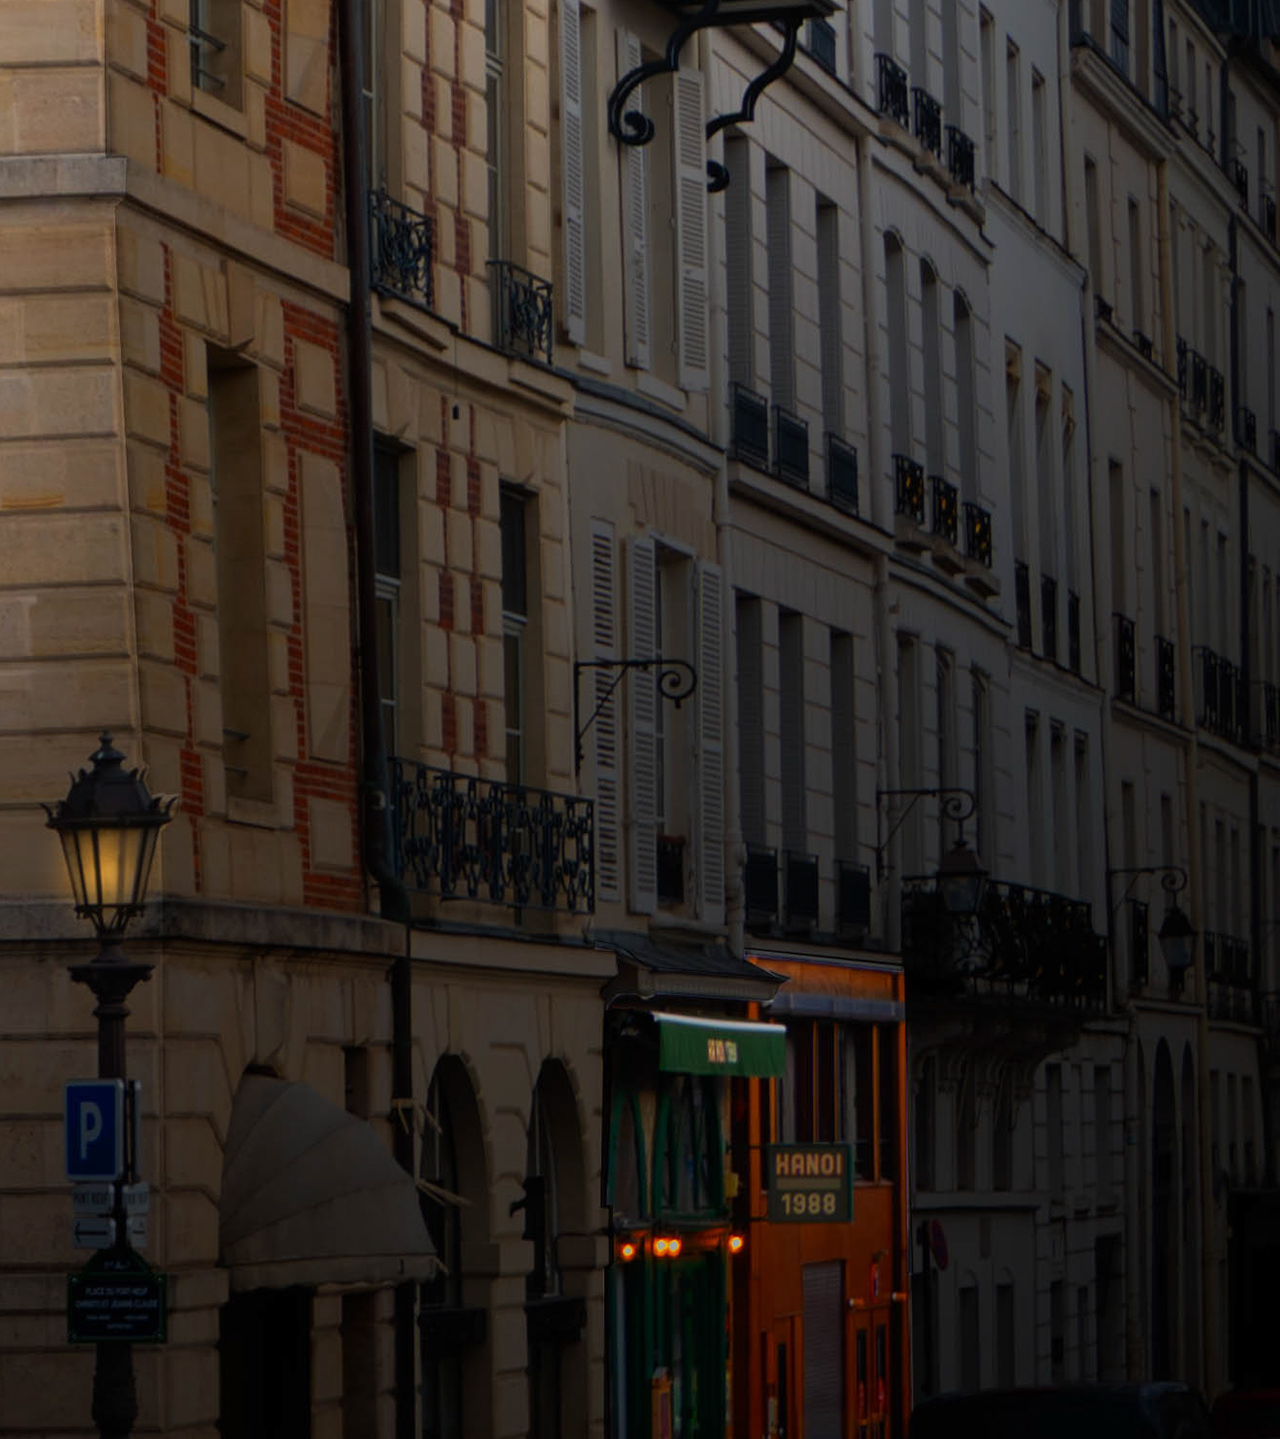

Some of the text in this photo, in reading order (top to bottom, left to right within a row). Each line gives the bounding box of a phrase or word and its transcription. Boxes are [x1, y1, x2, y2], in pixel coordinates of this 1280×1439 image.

[79, 1100, 104, 1161] P
[775, 1151, 844, 1177] HANOI
[781, 1191, 837, 1216] 1988
